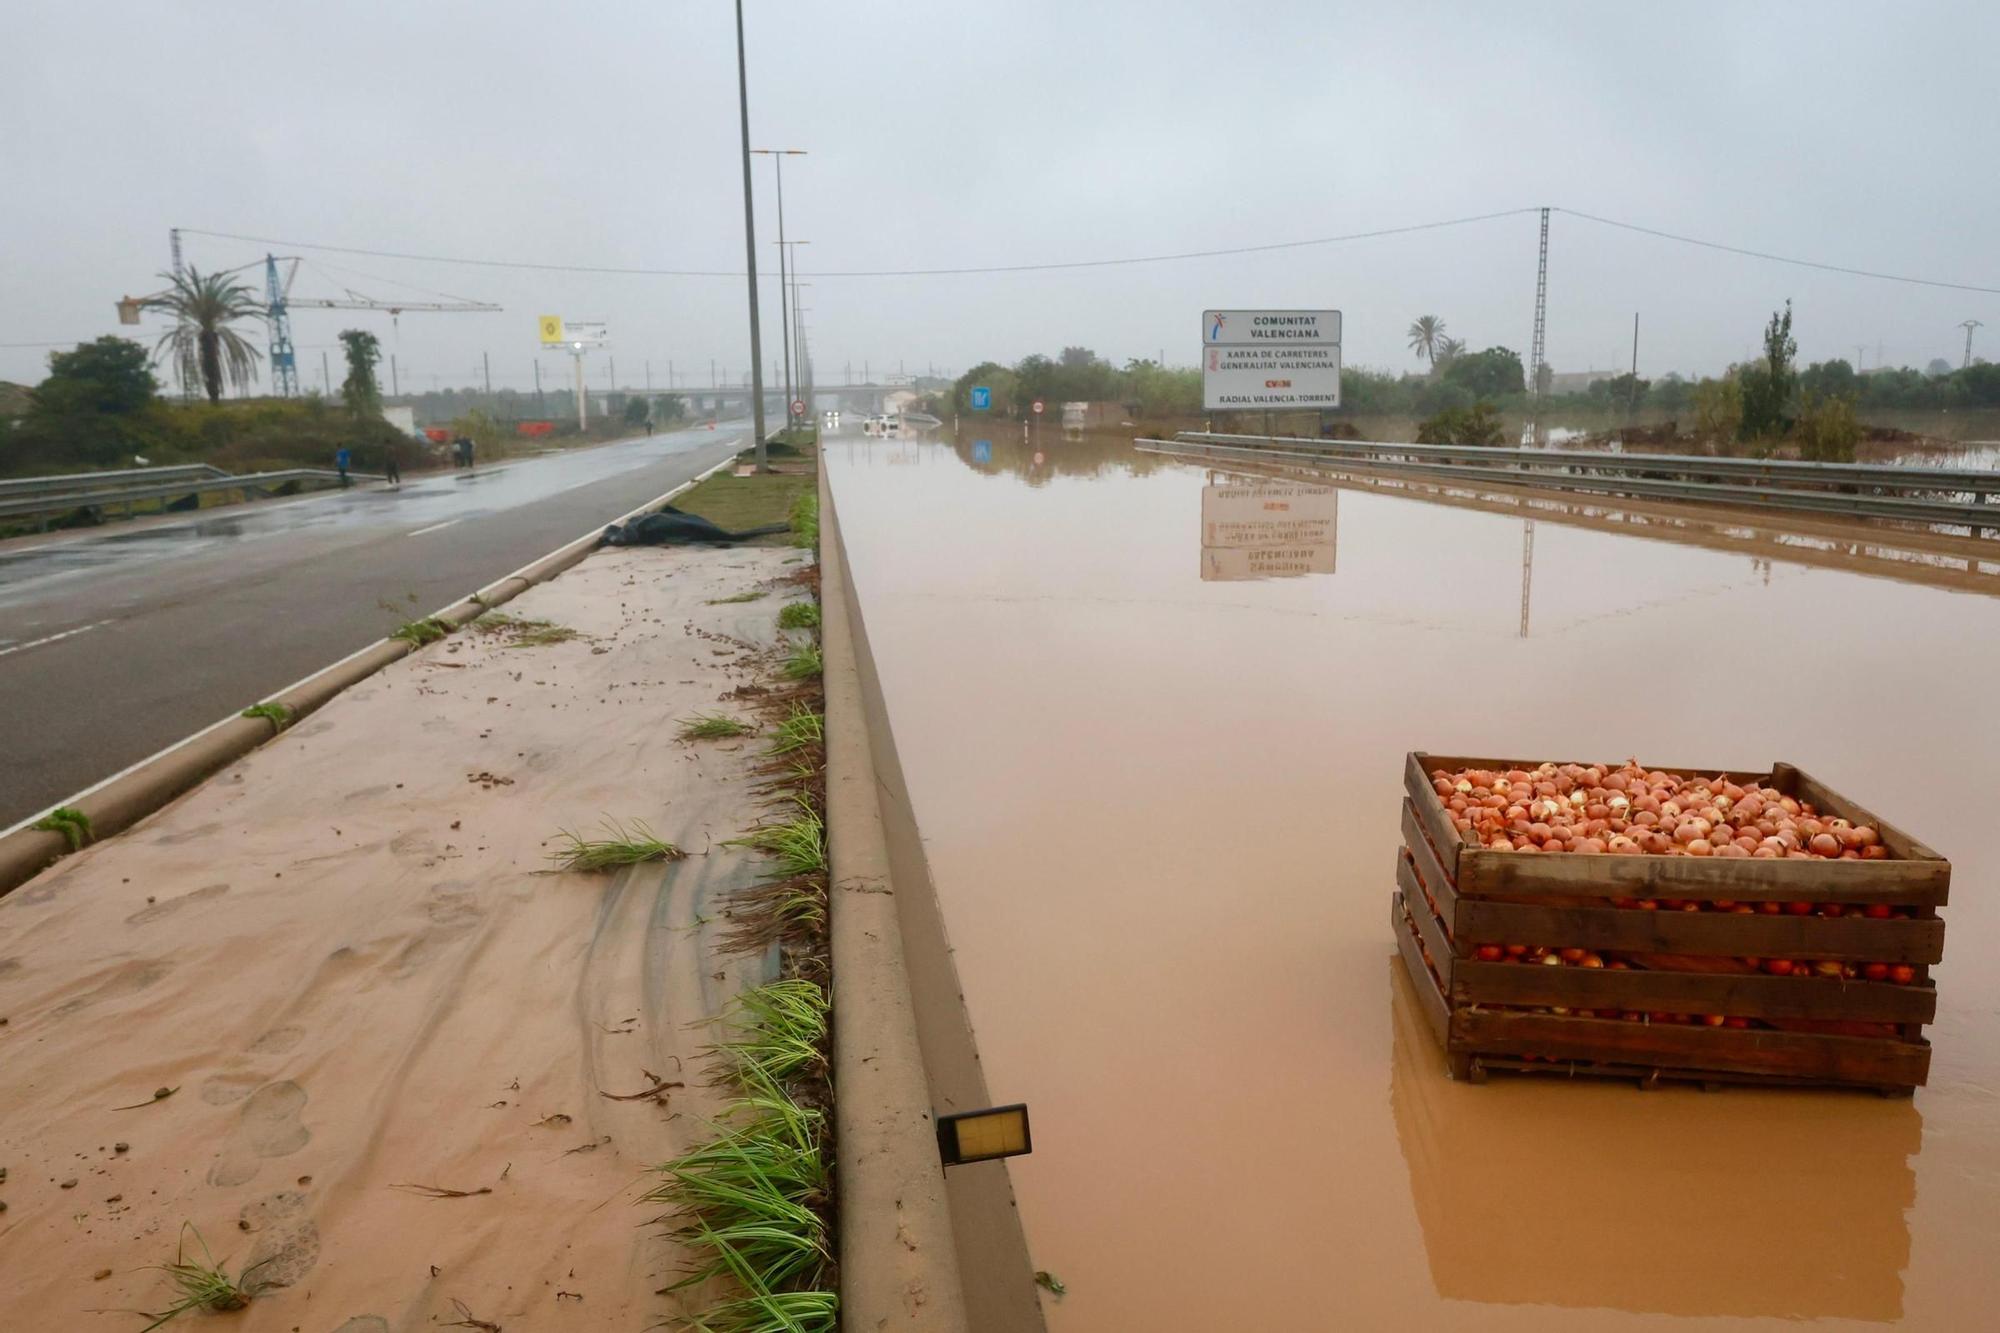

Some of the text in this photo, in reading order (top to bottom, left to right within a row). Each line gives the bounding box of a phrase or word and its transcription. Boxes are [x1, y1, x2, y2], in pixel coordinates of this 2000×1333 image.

[1253, 316, 1316, 325] COMUNITAT
[1250, 329, 1320, 338] VALENCIANA
[1227, 350, 1329, 359] XARXA DE CARRETERES
[1220, 361, 1334, 370] GENERALITAT VALENCIANA
[1219, 395, 1252, 404] RADIAL
